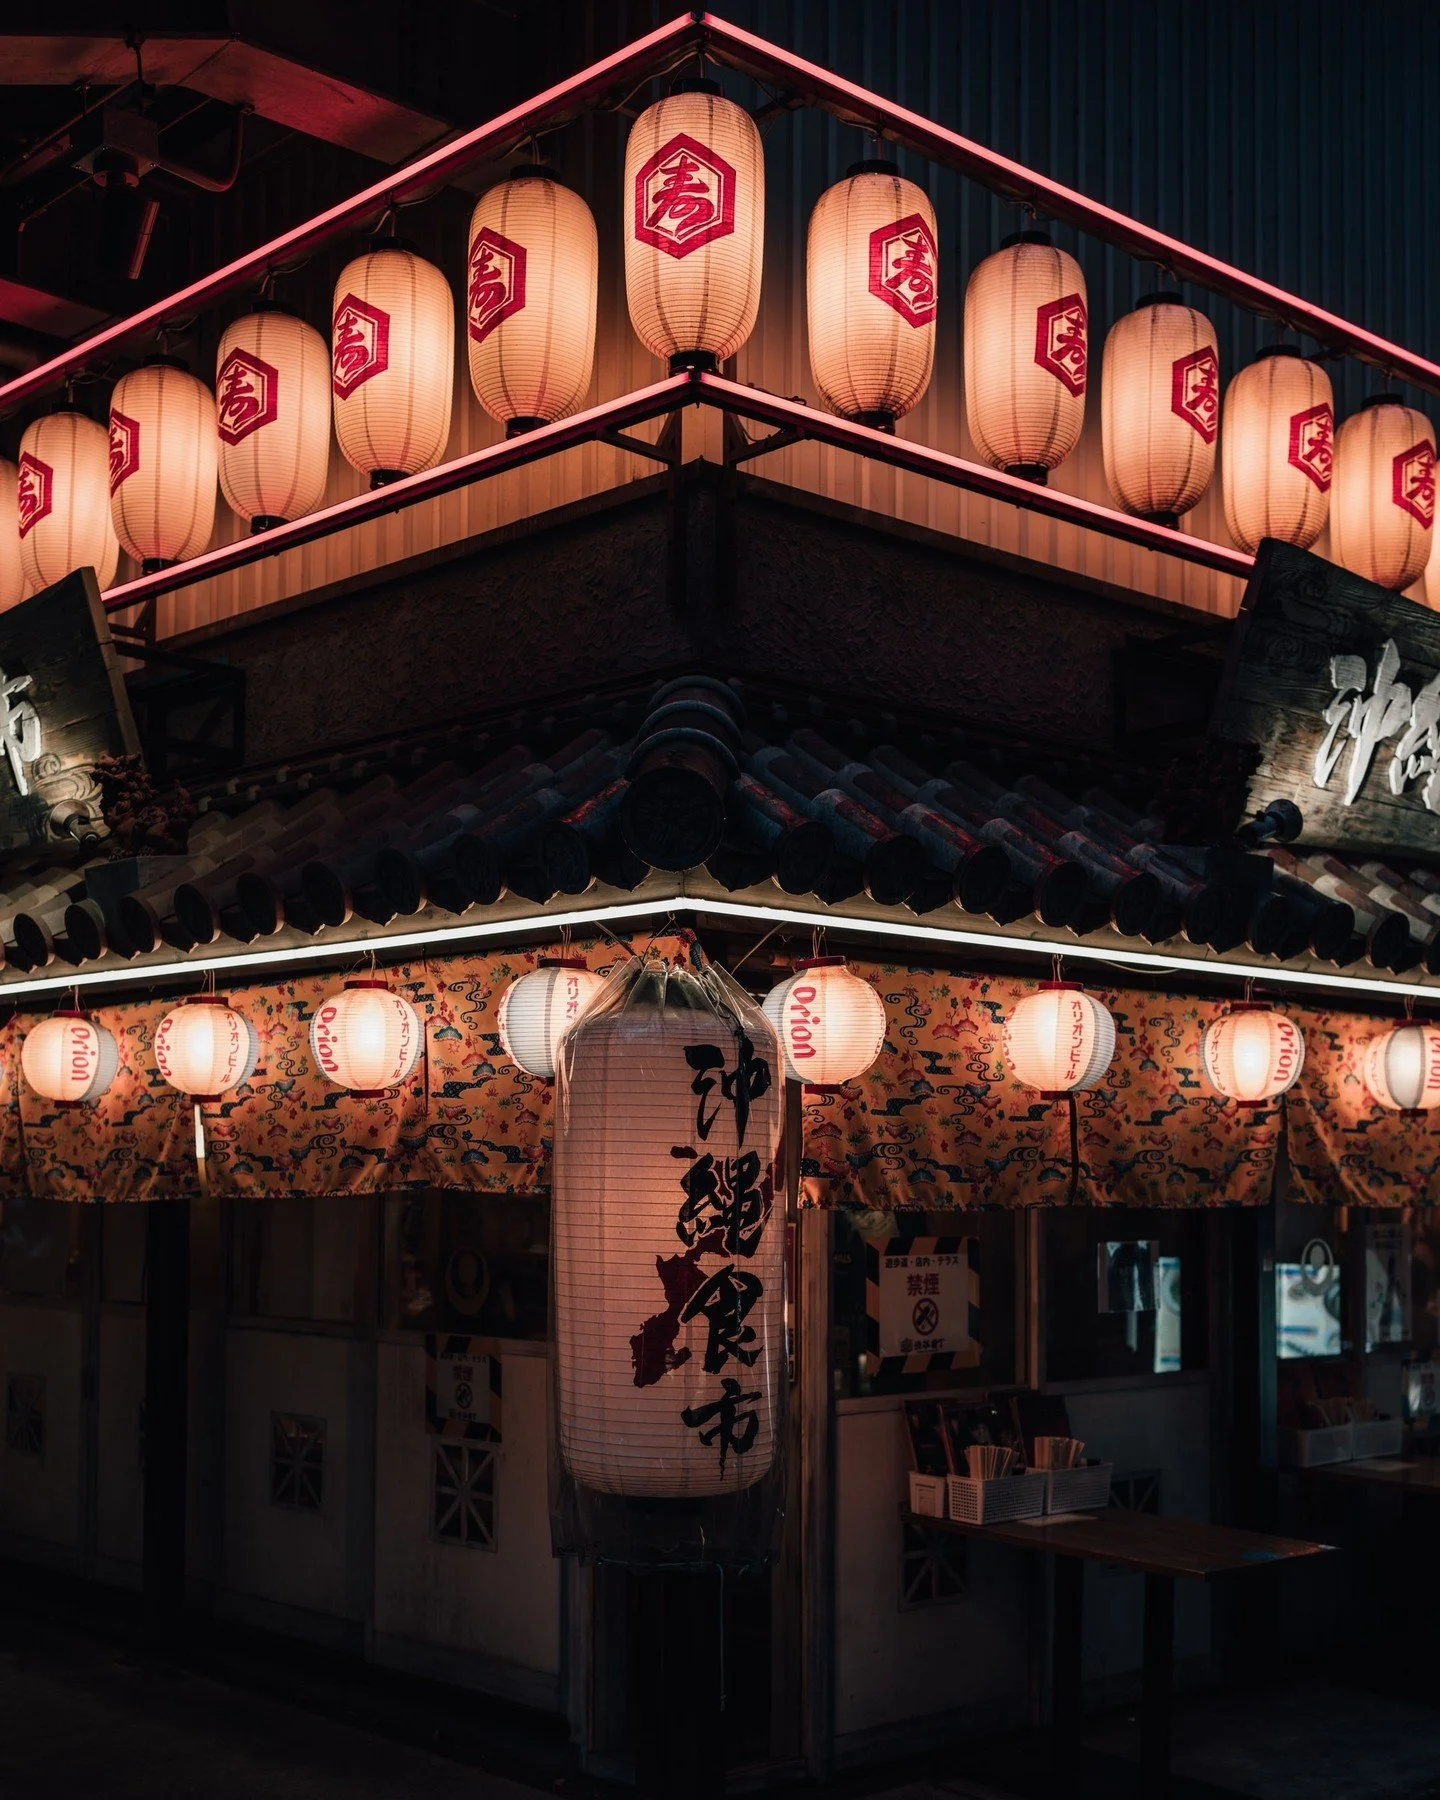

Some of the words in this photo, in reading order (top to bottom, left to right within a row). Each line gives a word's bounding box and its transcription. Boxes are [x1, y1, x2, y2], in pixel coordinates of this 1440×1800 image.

[646, 155, 714, 237] 寿
[70, 1027, 96, 1082] Orion
[155, 1018, 173, 1078] Orion
[220, 1012, 240, 1083] オリオンビール
[316, 1007, 339, 1073] Orion
[790, 986, 820, 1060] Orion
[1064, 1000, 1083, 1080] オリオンビール
[1274, 1022, 1298, 1082] Orion
[676, 1026, 772, 1481] 沖縄食市
[907, 1273, 939, 1296] 禁煙
